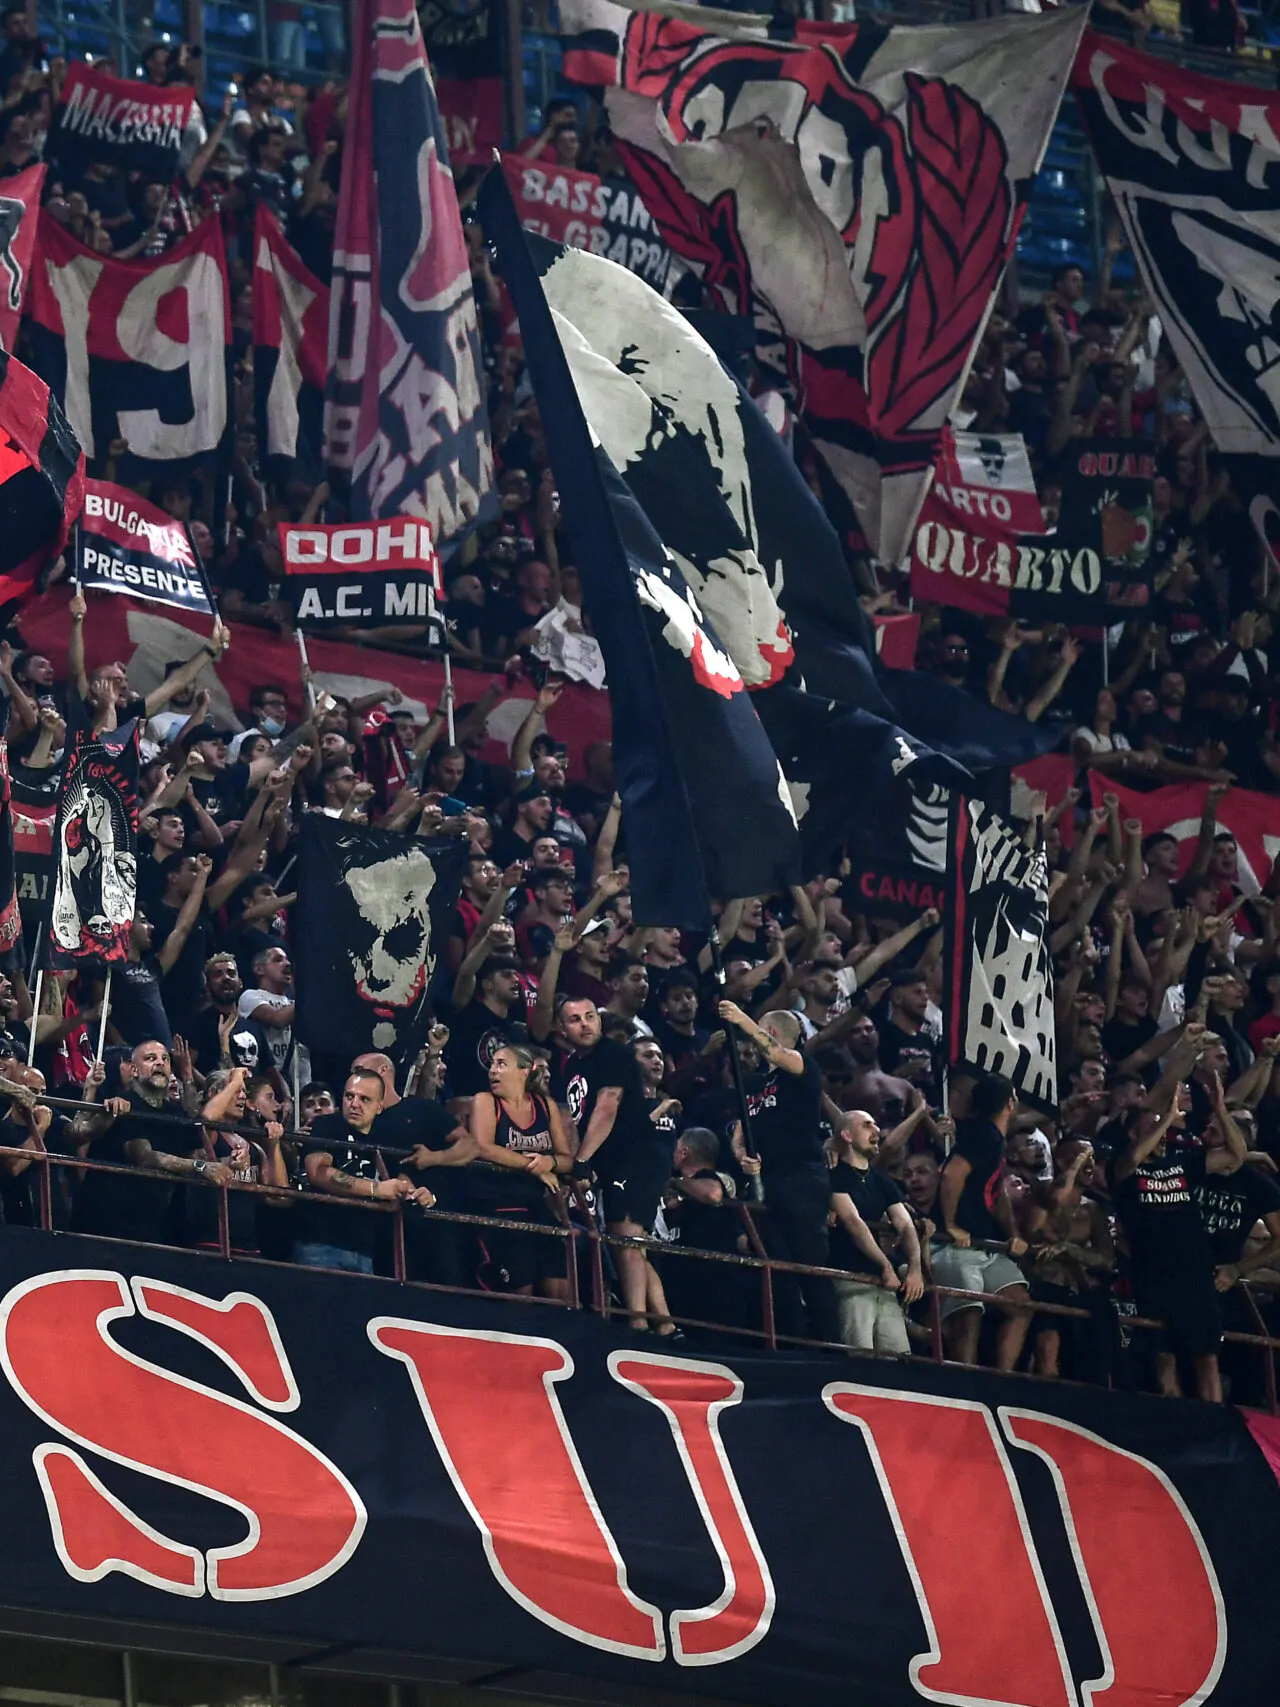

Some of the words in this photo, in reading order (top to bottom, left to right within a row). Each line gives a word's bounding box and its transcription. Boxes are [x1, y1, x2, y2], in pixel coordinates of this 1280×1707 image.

[521, 168, 661, 238] BASSAN
[83, 546, 208, 601] PRESENTE
[916, 520, 1102, 595] QUARTO
[297, 584, 372, 618] A.C.
